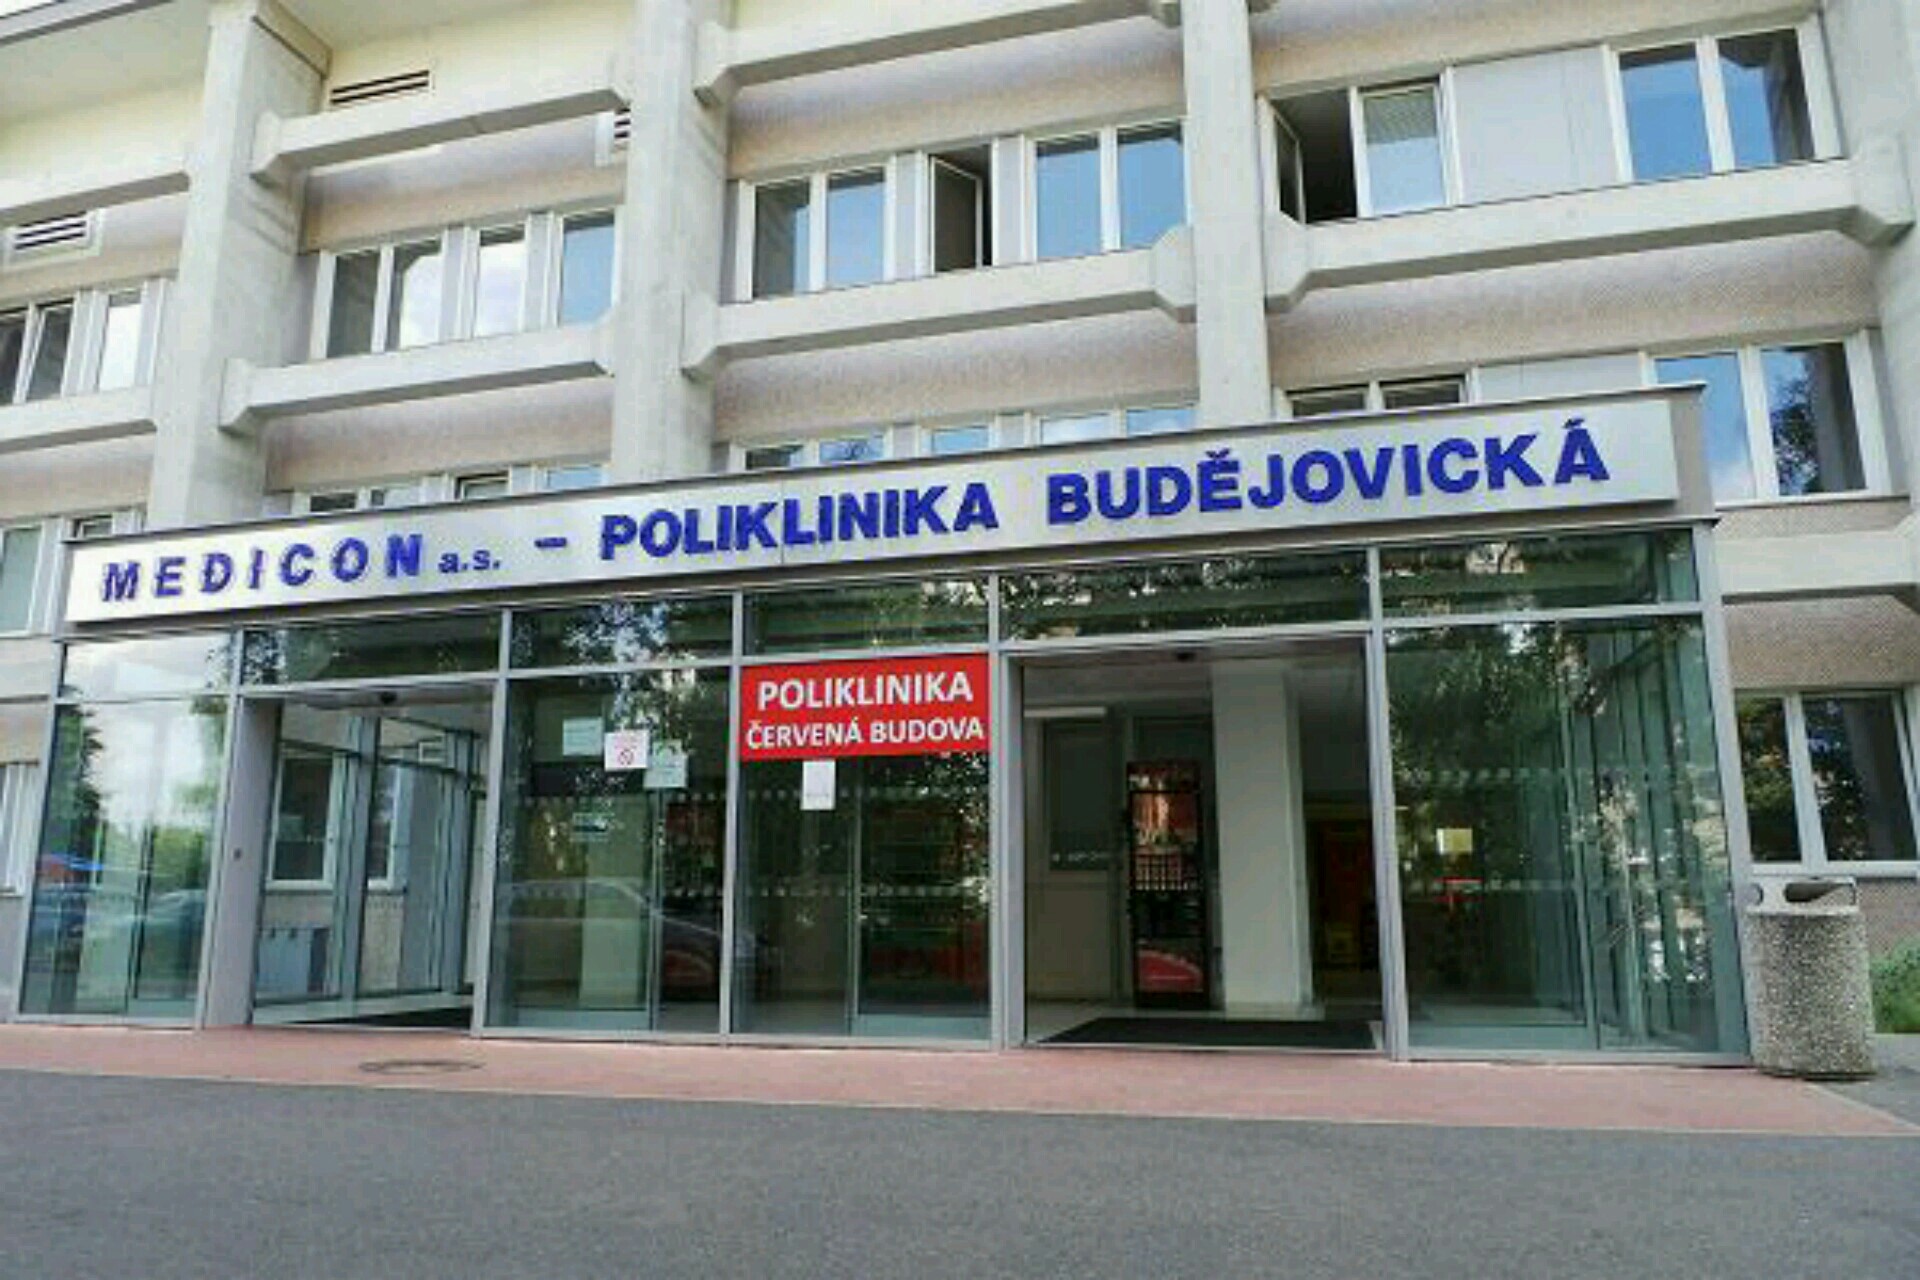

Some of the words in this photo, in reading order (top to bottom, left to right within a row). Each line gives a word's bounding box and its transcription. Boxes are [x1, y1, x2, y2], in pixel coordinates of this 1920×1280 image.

[101, 534, 424, 602] MEDICON
[437, 550, 502, 575] a.s.
[600, 482, 998, 562] POLIKLINIKA
[1046, 415, 1610, 526] BUDĚJOVICKÁ
[757, 670, 974, 711] POLIKLINIKA
[746, 715, 865, 751] ČERVENÁ
[869, 716, 985, 745] BUDOVA
